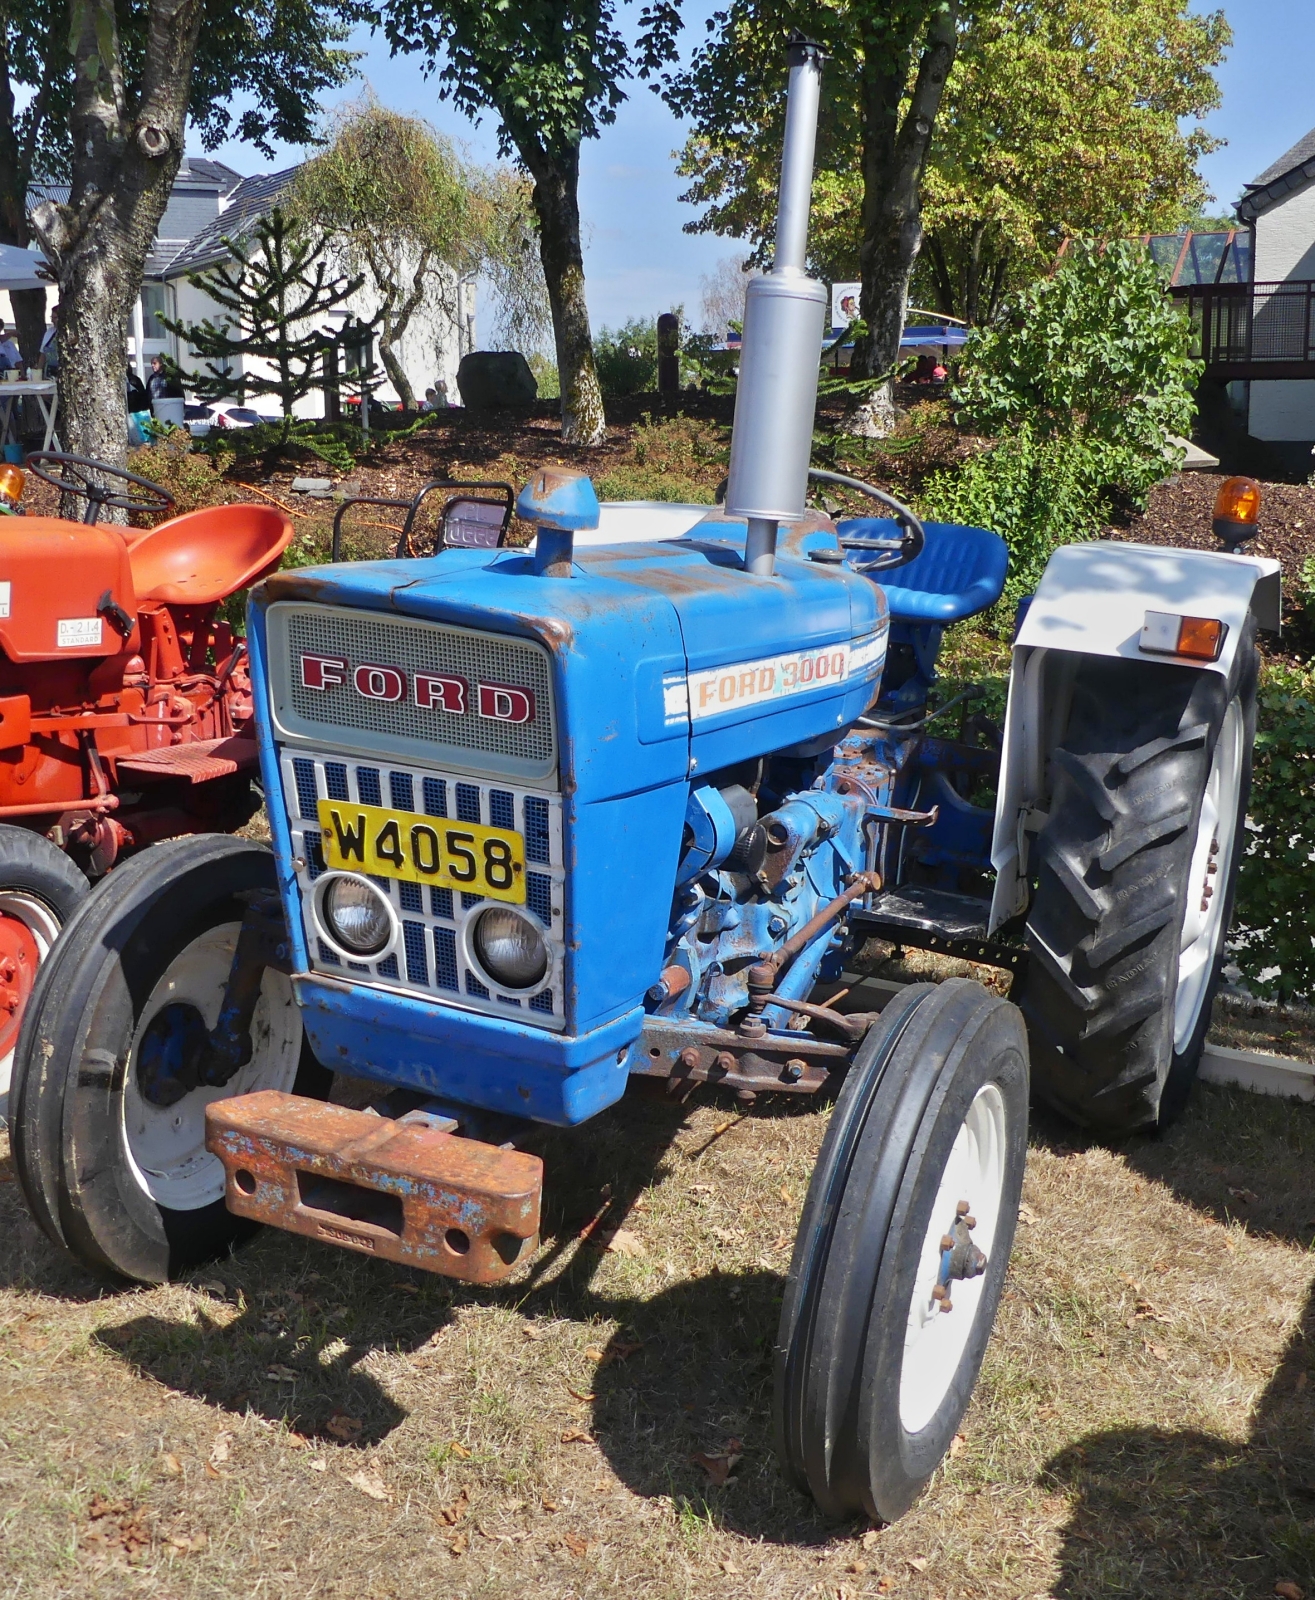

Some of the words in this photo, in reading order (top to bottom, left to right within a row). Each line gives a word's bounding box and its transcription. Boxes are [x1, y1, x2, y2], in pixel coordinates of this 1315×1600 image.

[62, 636, 98, 644] STANDARD
[301, 651, 536, 723] FORD
[699, 667, 775, 708] FORD
[783, 651, 845, 687] 3000
[331, 809, 513, 890] W4058
